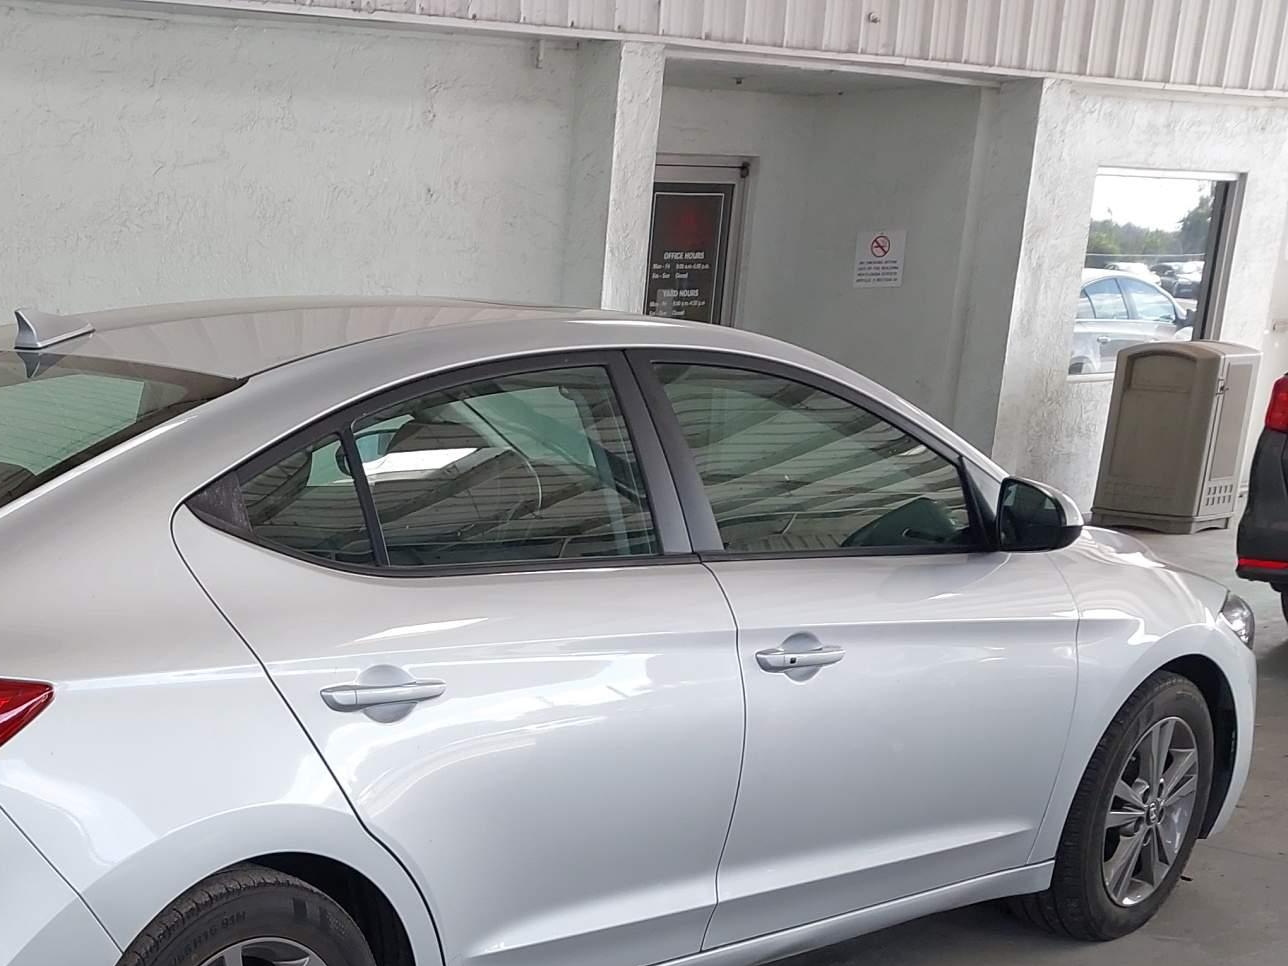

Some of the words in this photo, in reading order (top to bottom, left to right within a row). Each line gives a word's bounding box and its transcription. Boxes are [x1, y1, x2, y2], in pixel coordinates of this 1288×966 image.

[663, 251, 684, 260] OFFICE
[684, 251, 705, 260] HOURS
[679, 289, 699, 297] HOURS
